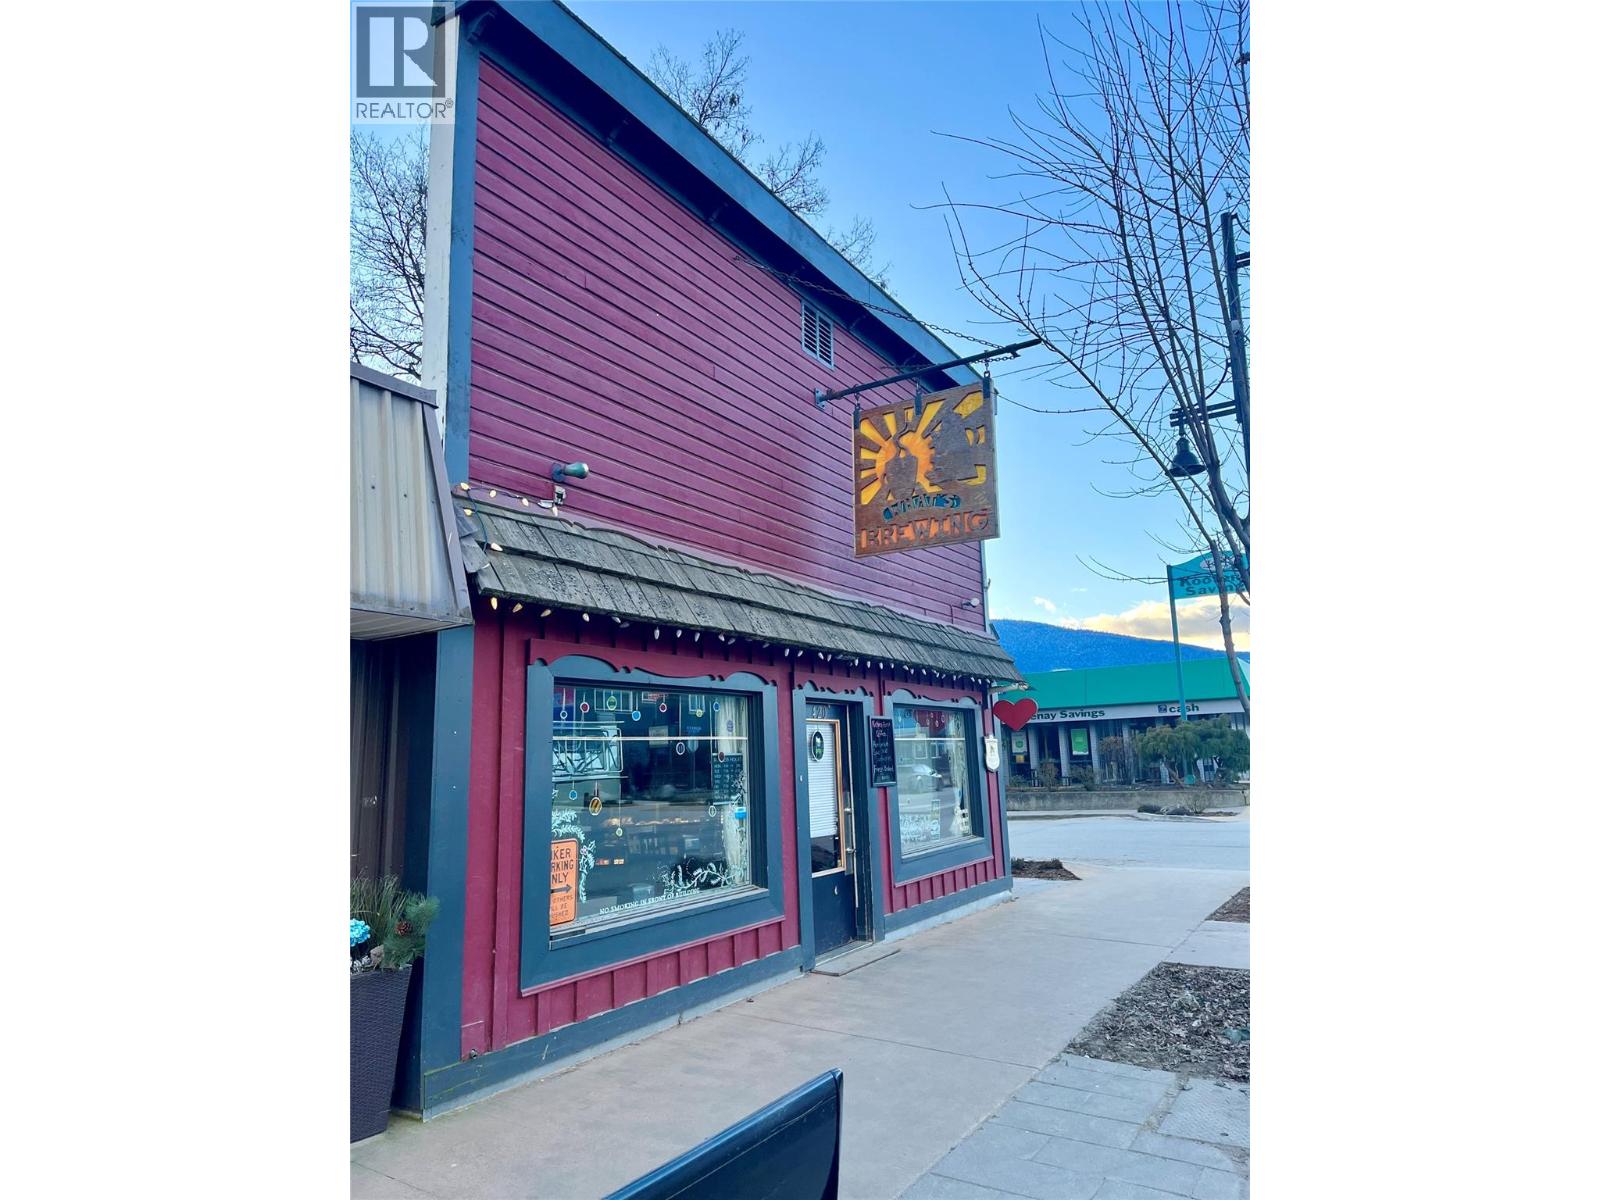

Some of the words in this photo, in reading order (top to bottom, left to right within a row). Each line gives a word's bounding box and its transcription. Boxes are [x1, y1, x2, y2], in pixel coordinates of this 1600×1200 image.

[861, 508, 989, 549] BREWING
[1060, 708, 1105, 719] Savings
[600, 907, 610, 915] NO
[610, 900, 639, 912] SMOKING
